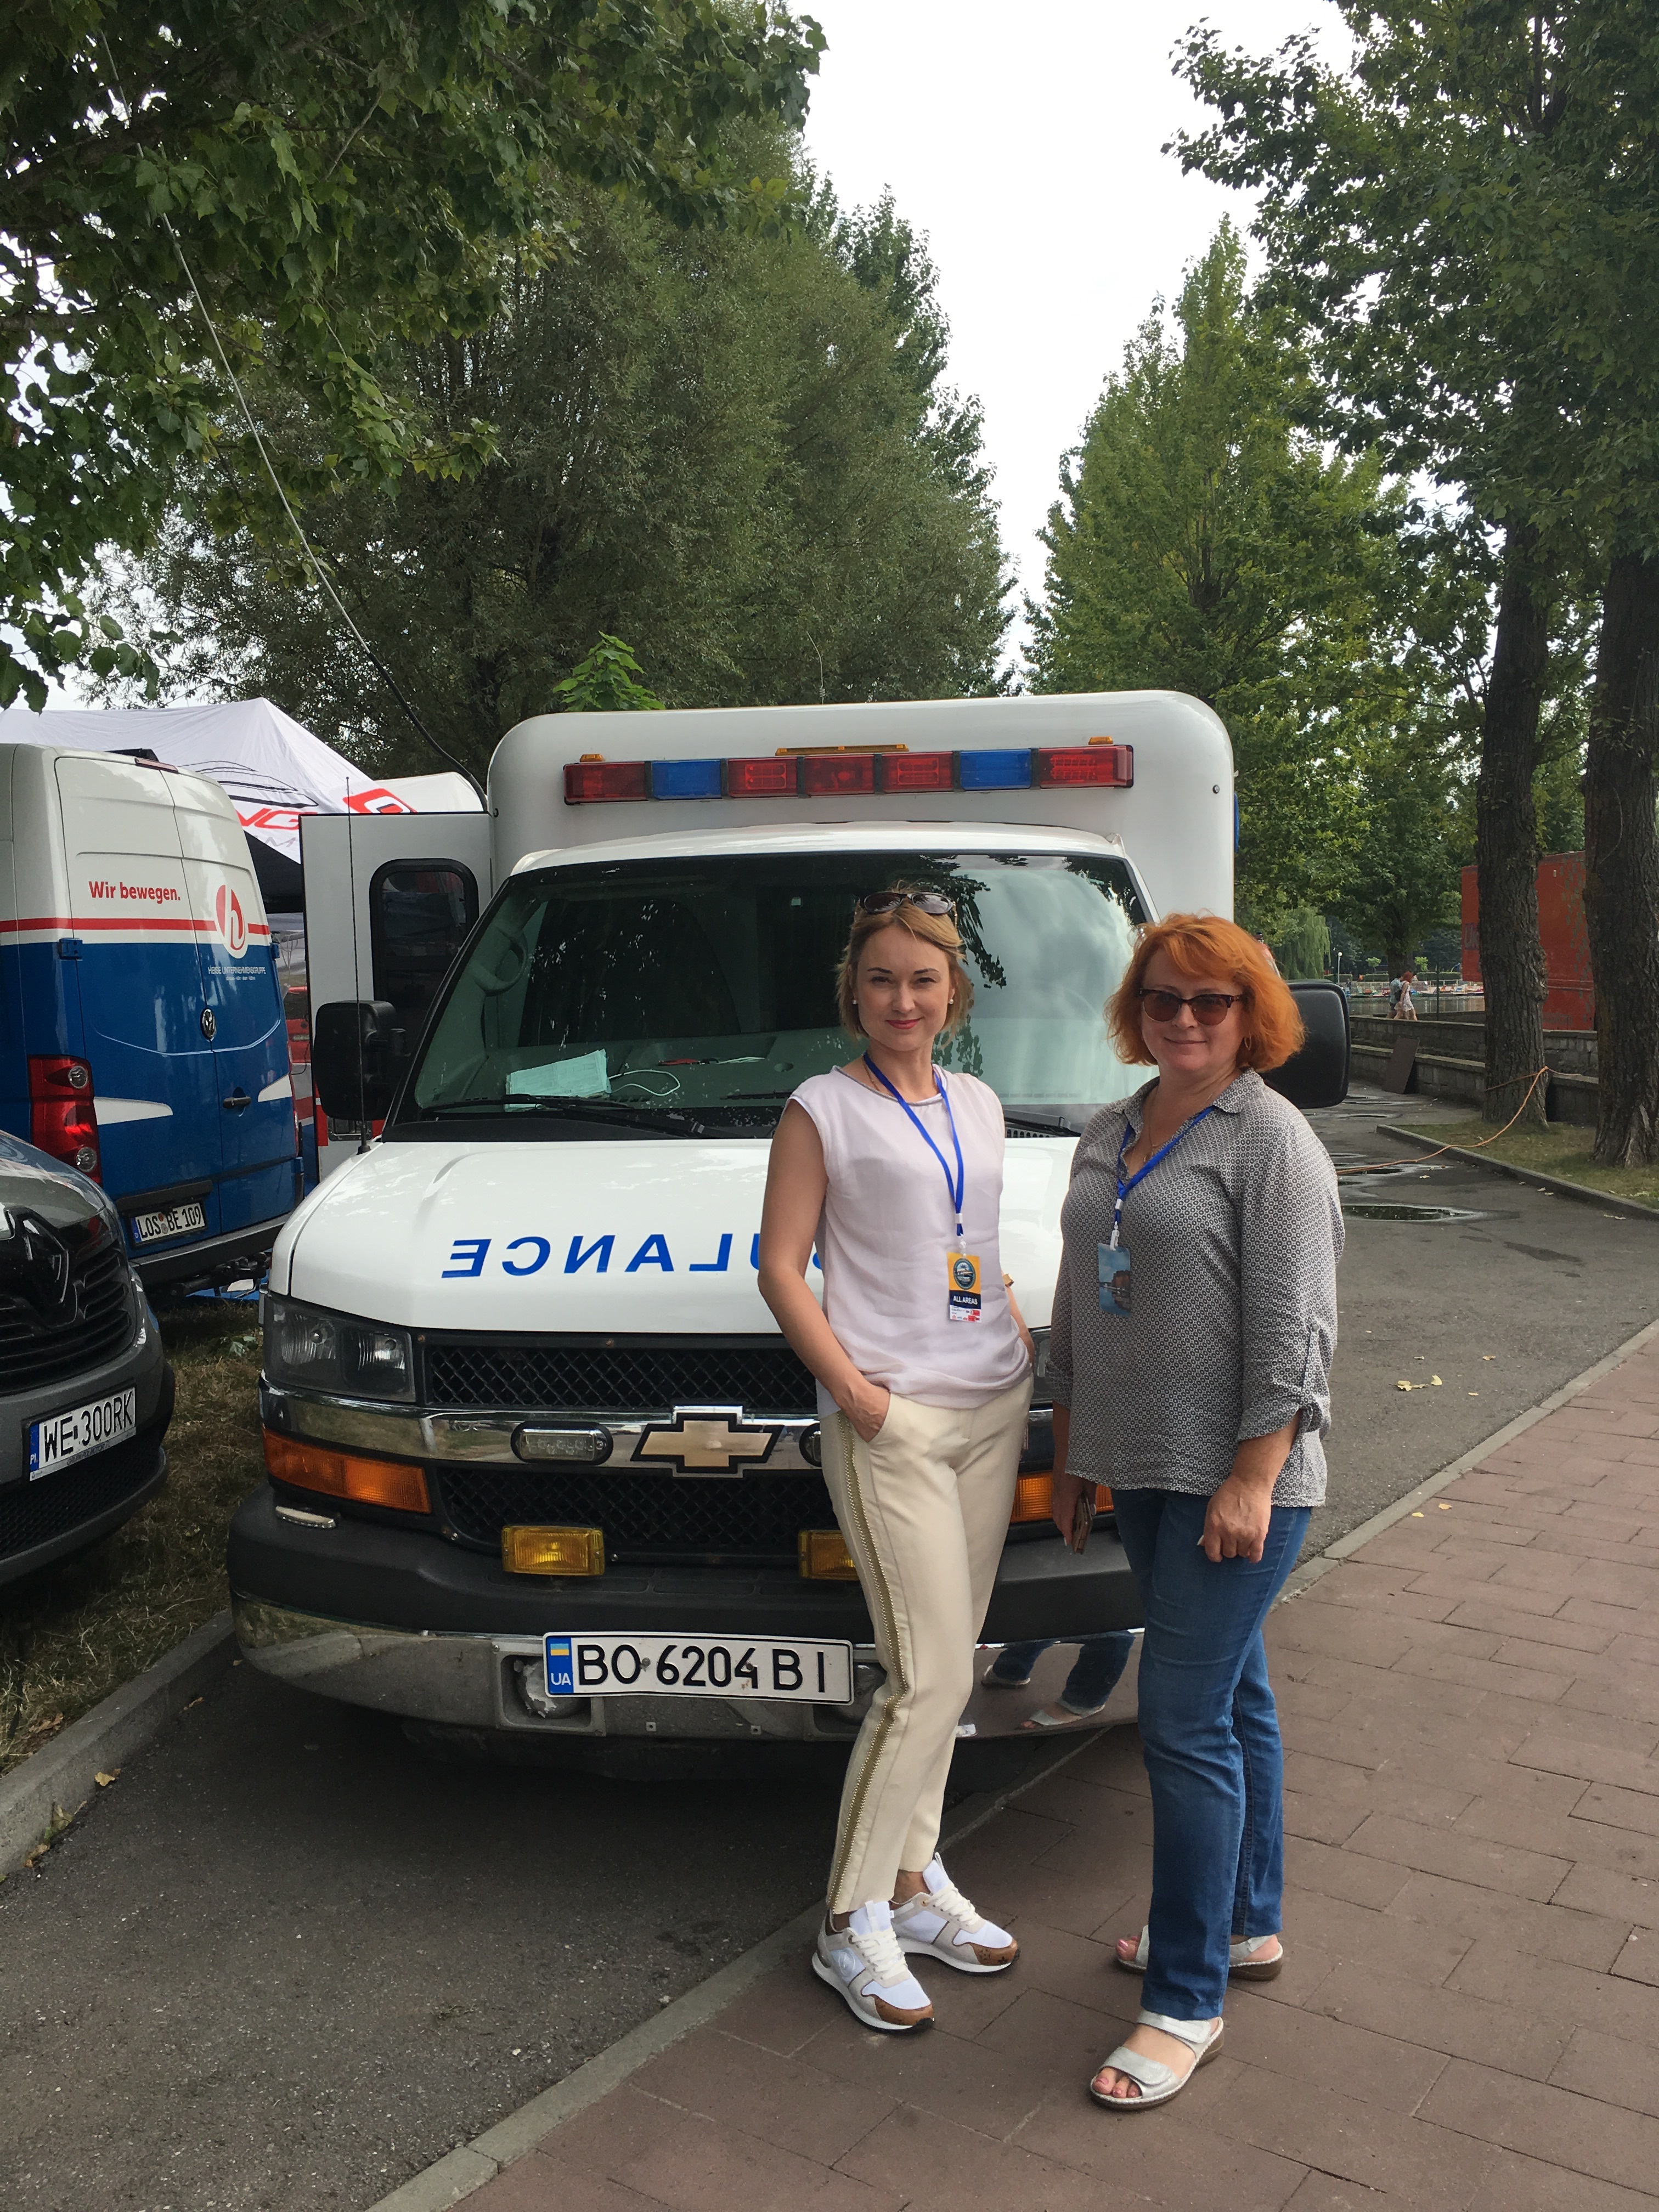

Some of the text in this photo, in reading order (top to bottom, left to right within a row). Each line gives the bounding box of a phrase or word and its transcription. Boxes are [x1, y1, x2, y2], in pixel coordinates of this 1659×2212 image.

[88, 881, 180, 904] Wir bewegen.
[137, 1206, 201, 1239] LOS BE 109
[962, 1296, 978, 1305] AREAS
[44, 1415, 74, 1463] WE
[81, 1391, 133, 1446] 300RK
[551, 1672, 572, 1686] UA
[577, 1644, 825, 1693] BO 6204 BI
